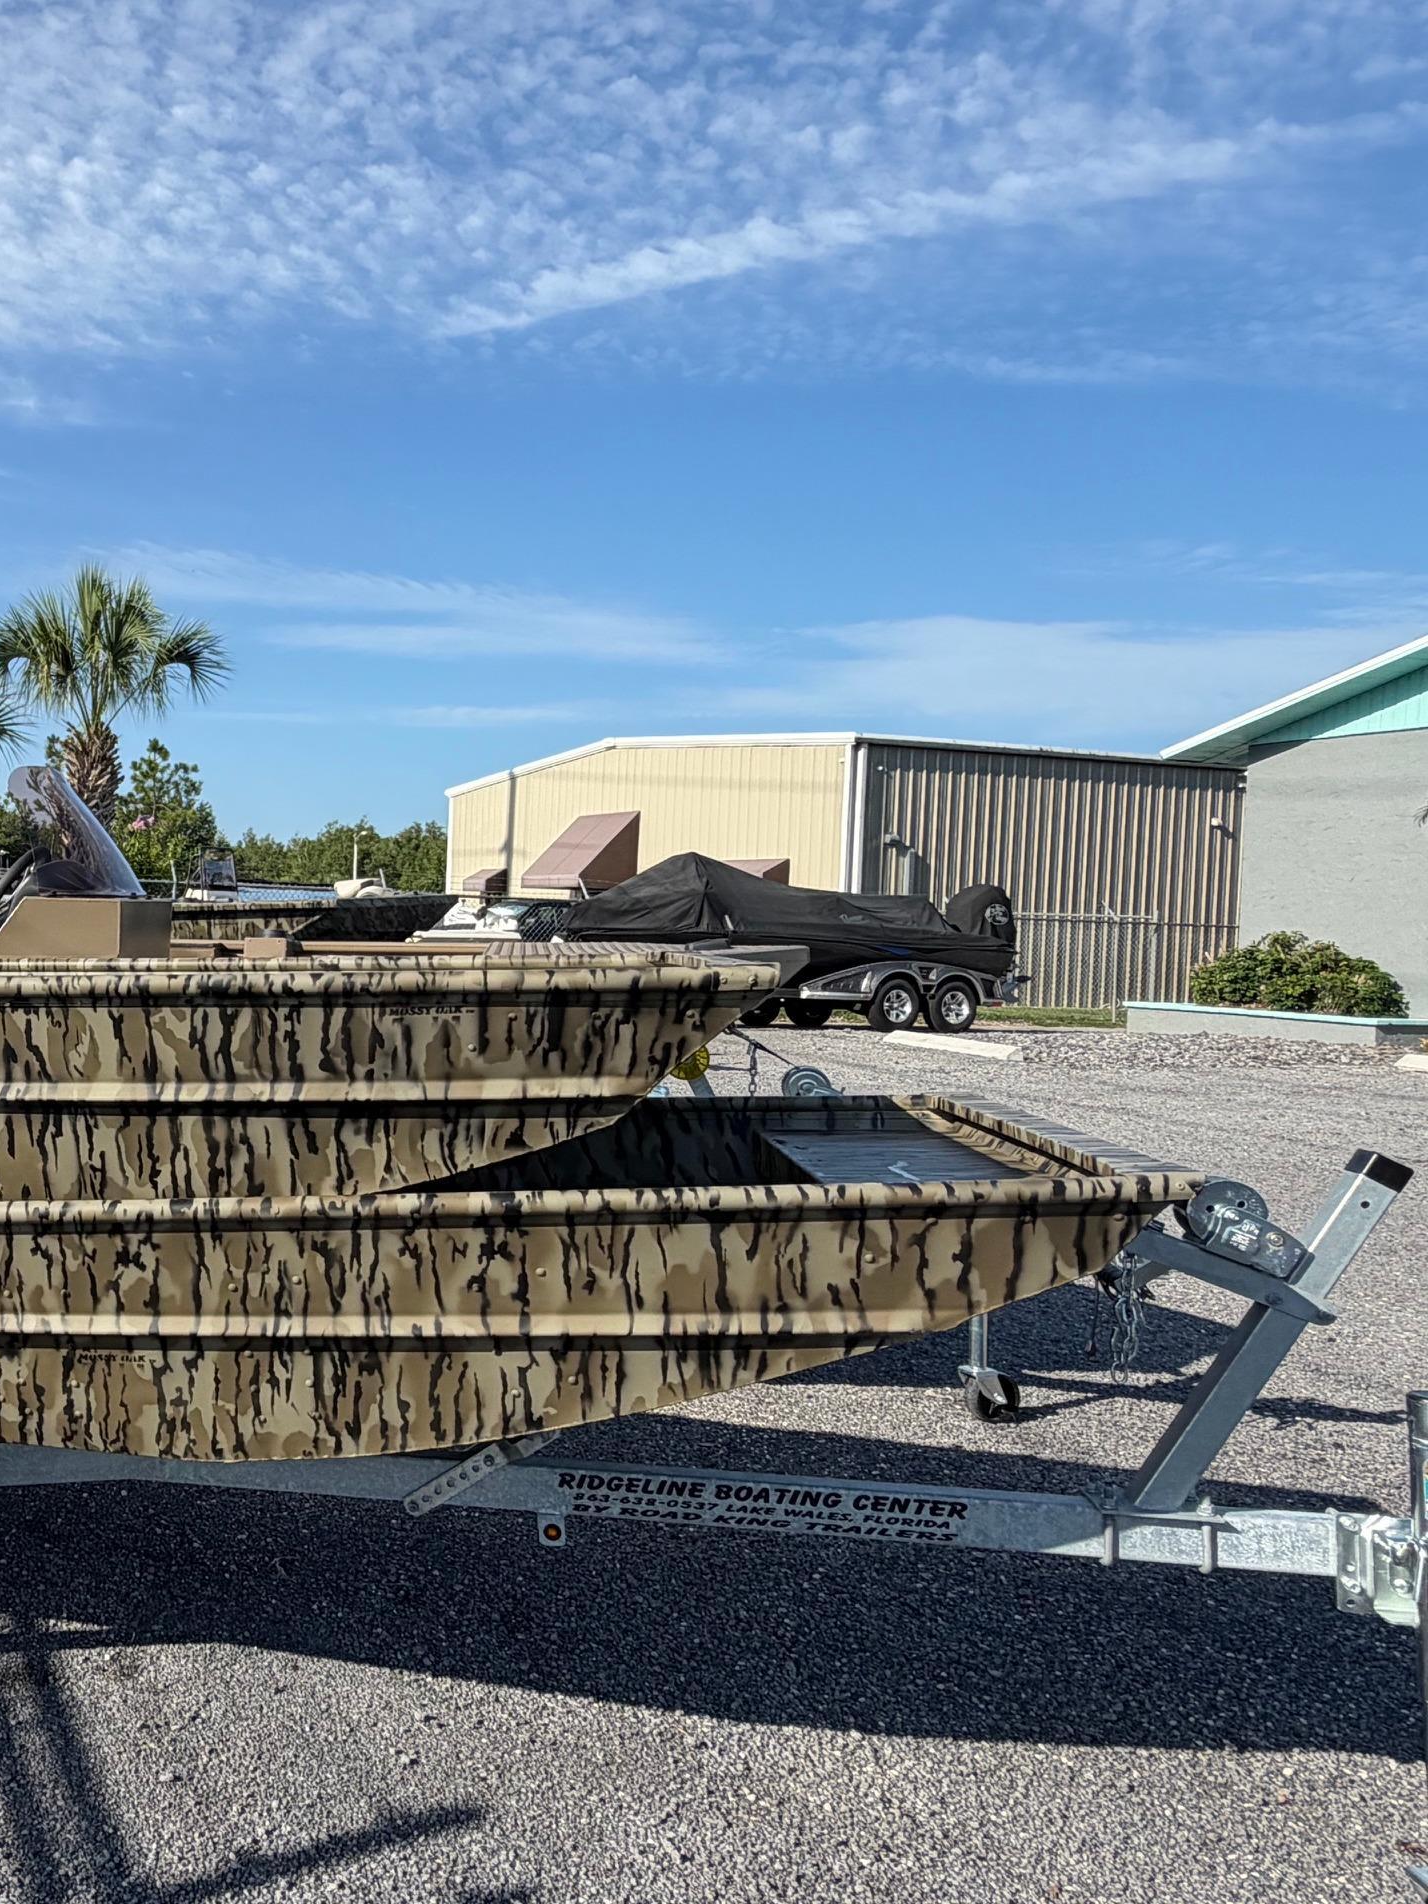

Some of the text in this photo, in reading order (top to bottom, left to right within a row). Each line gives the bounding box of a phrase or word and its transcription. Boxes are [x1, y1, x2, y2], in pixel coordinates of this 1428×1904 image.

[558, 1472, 969, 1520] RIDGELINE BOATING CENTER
[573, 1492, 951, 1529] 863-638-0537 LAKE WALES, FLORIDA
[572, 1503, 959, 1542] BY ROAD KING TRAILERS
